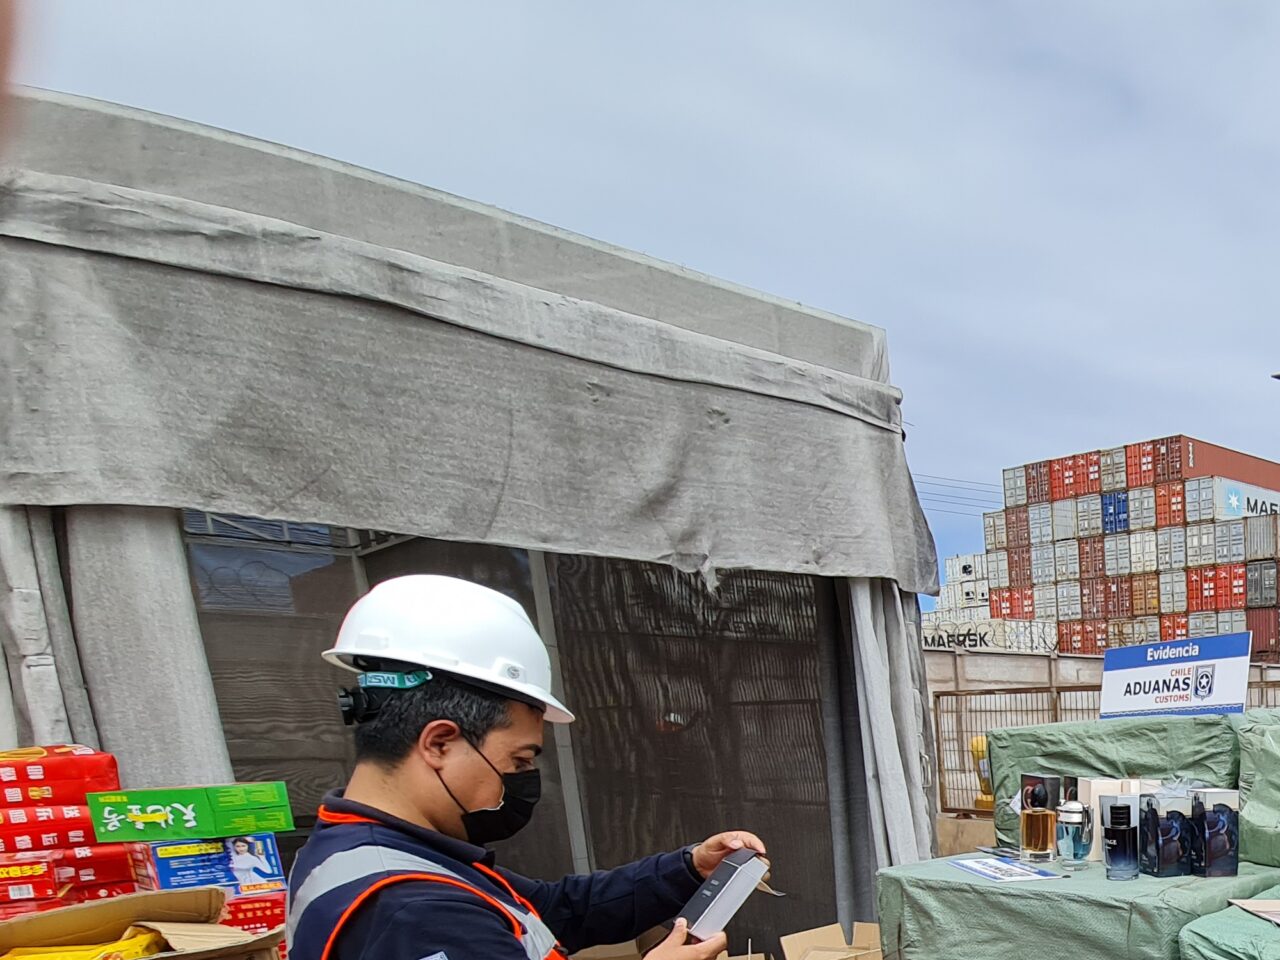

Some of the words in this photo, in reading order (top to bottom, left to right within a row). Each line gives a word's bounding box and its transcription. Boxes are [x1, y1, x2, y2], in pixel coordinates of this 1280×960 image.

[923, 630, 989, 649] MAERSK
[1146, 643, 1199, 661] Evidencia
[1170, 667, 1192, 677] CHILE
[1123, 677, 1191, 696] ADUANAS
[1154, 695, 1190, 704] CUSTOMS
